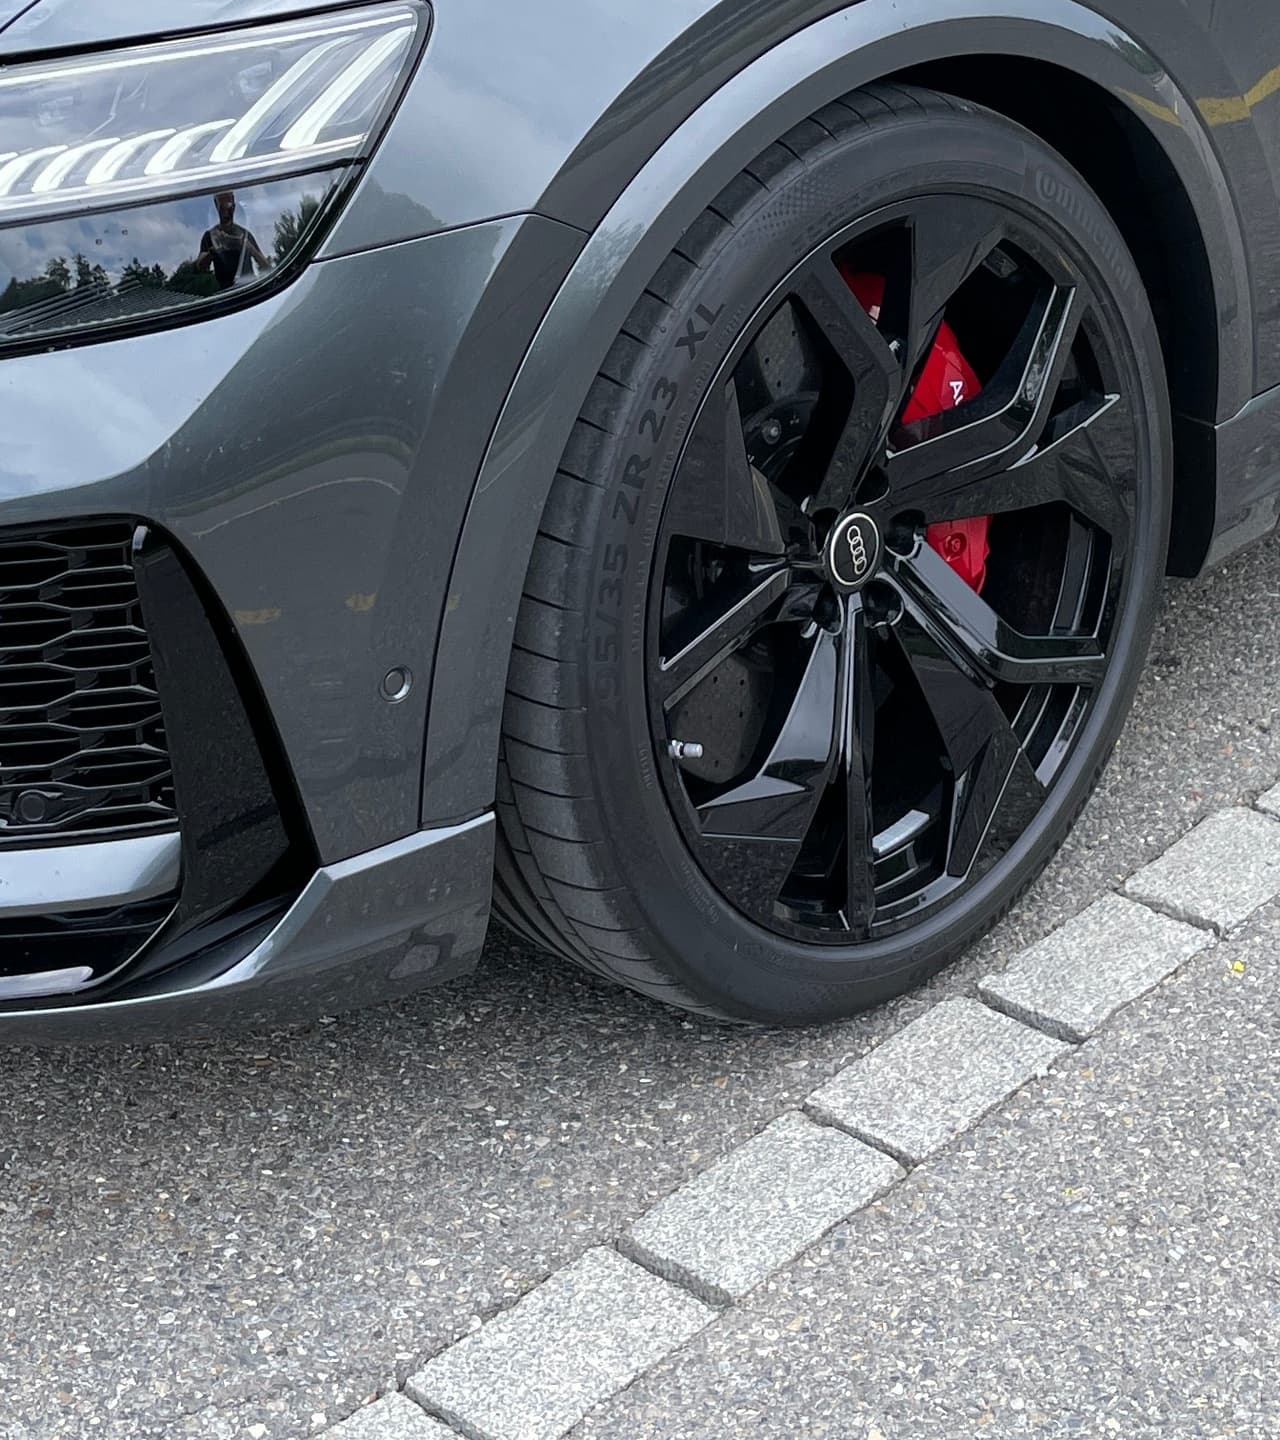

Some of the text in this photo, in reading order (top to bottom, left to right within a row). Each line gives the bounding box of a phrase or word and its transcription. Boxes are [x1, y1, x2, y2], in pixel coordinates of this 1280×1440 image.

[612, 454, 653, 526] ZR
[639, 376, 679, 444] 23
[675, 303, 725, 361] XL
